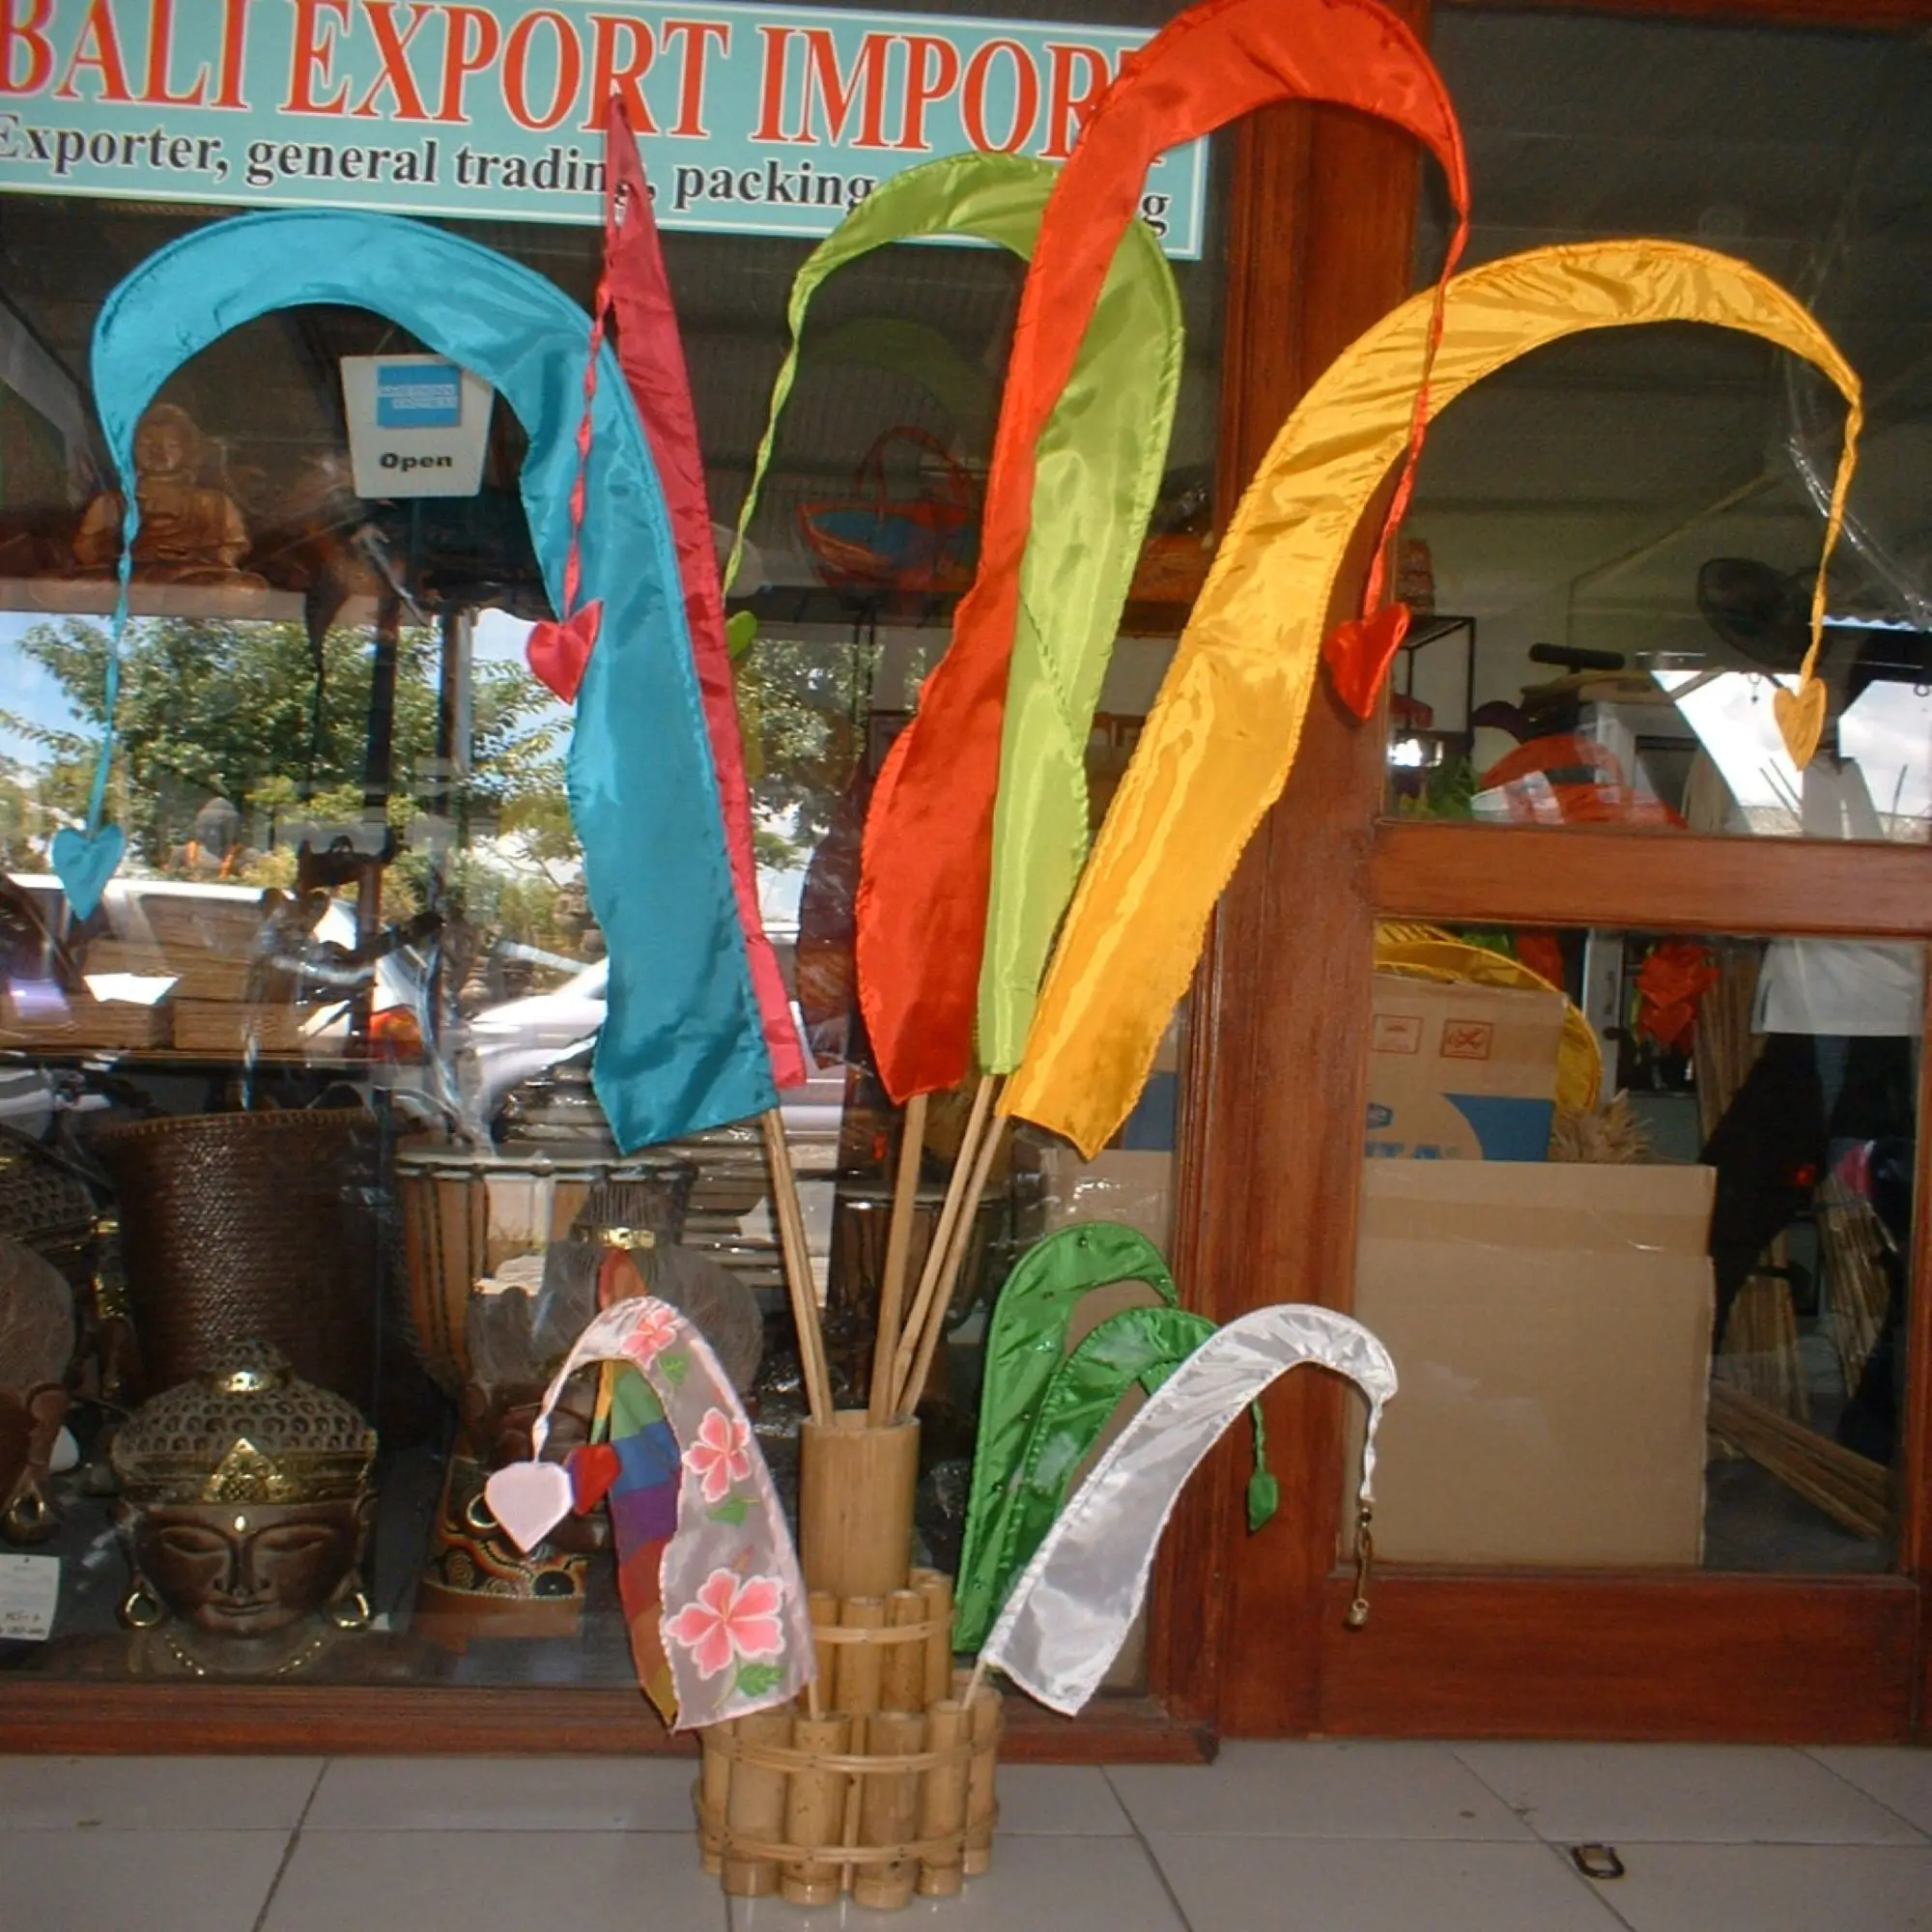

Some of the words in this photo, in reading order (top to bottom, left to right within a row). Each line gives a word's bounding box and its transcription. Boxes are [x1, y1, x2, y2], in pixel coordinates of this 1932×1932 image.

[0, 0, 249, 110] BALI
[280, 0, 730, 136] EXPORT
[752, 25, 1165, 166] IMPOR
[0, 113, 229, 182] Exporter,
[246, 140, 438, 185] general
[455, 148, 657, 205] tradin,
[379, 451, 454, 473] Open
